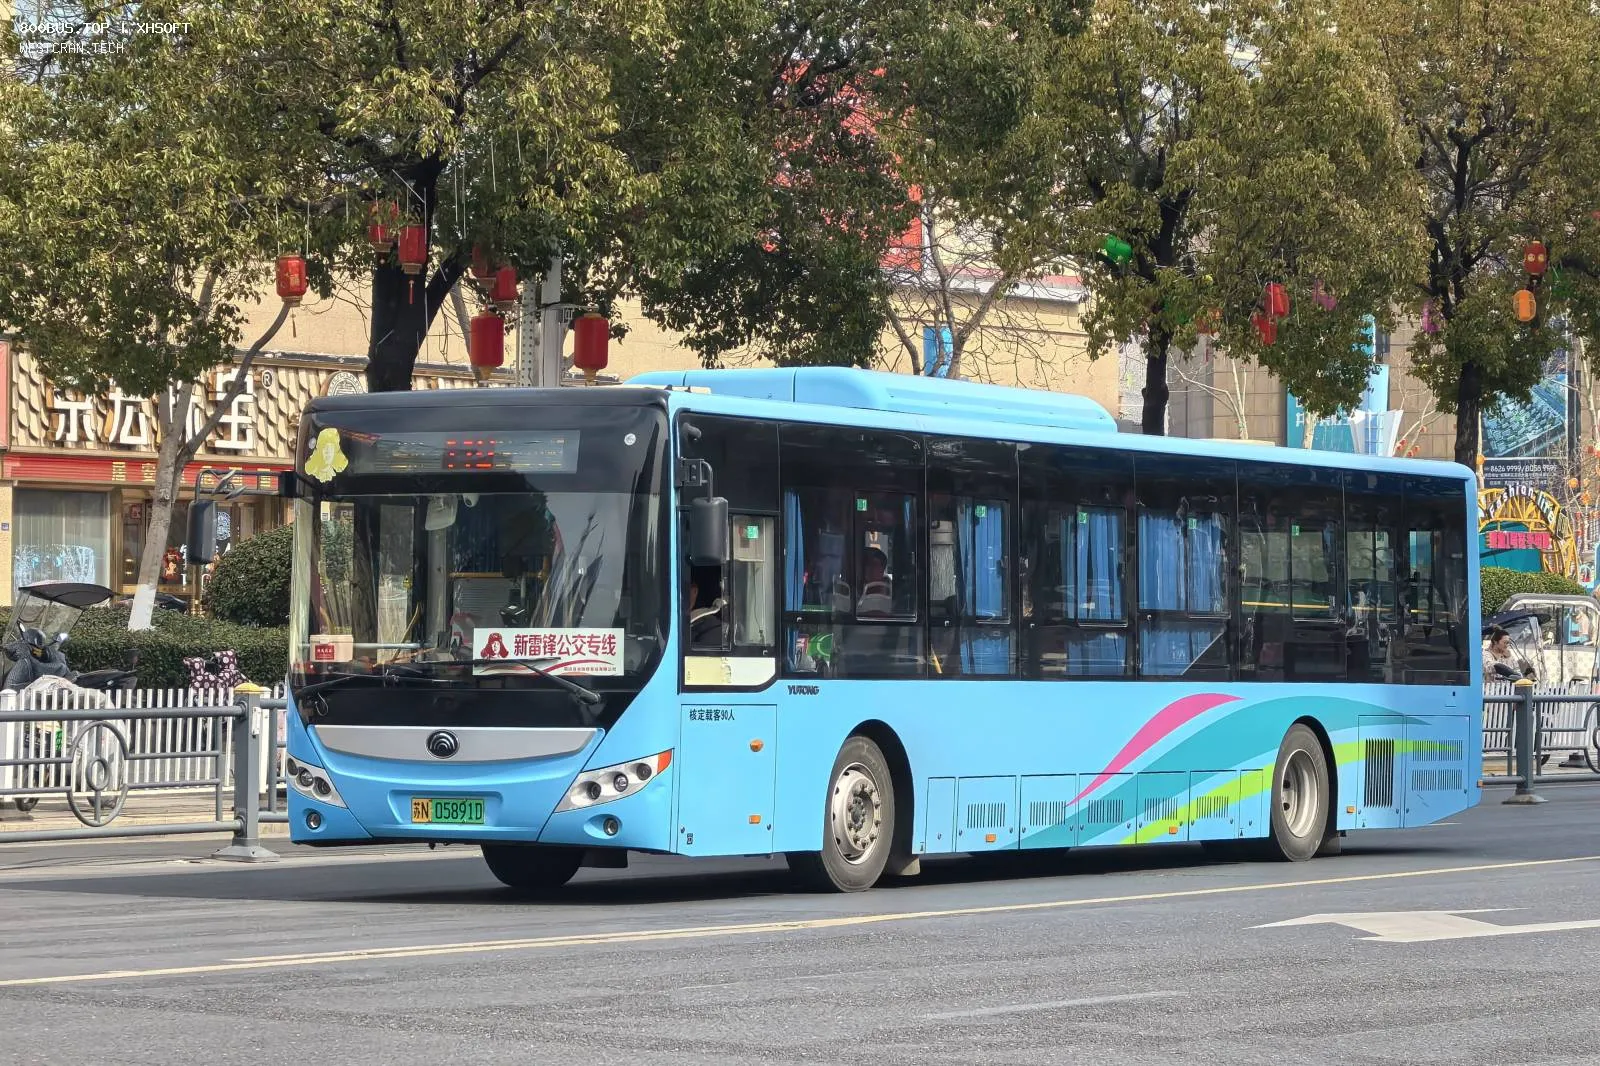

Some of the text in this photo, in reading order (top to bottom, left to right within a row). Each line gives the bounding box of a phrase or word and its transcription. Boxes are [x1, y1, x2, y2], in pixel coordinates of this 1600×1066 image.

[513, 633, 617, 657] 新雷锋公交专线
[787, 684, 820, 696] YUTONG
[689, 708, 735, 721] 核定载客90人
[435, 802, 483, 820] 05891D
